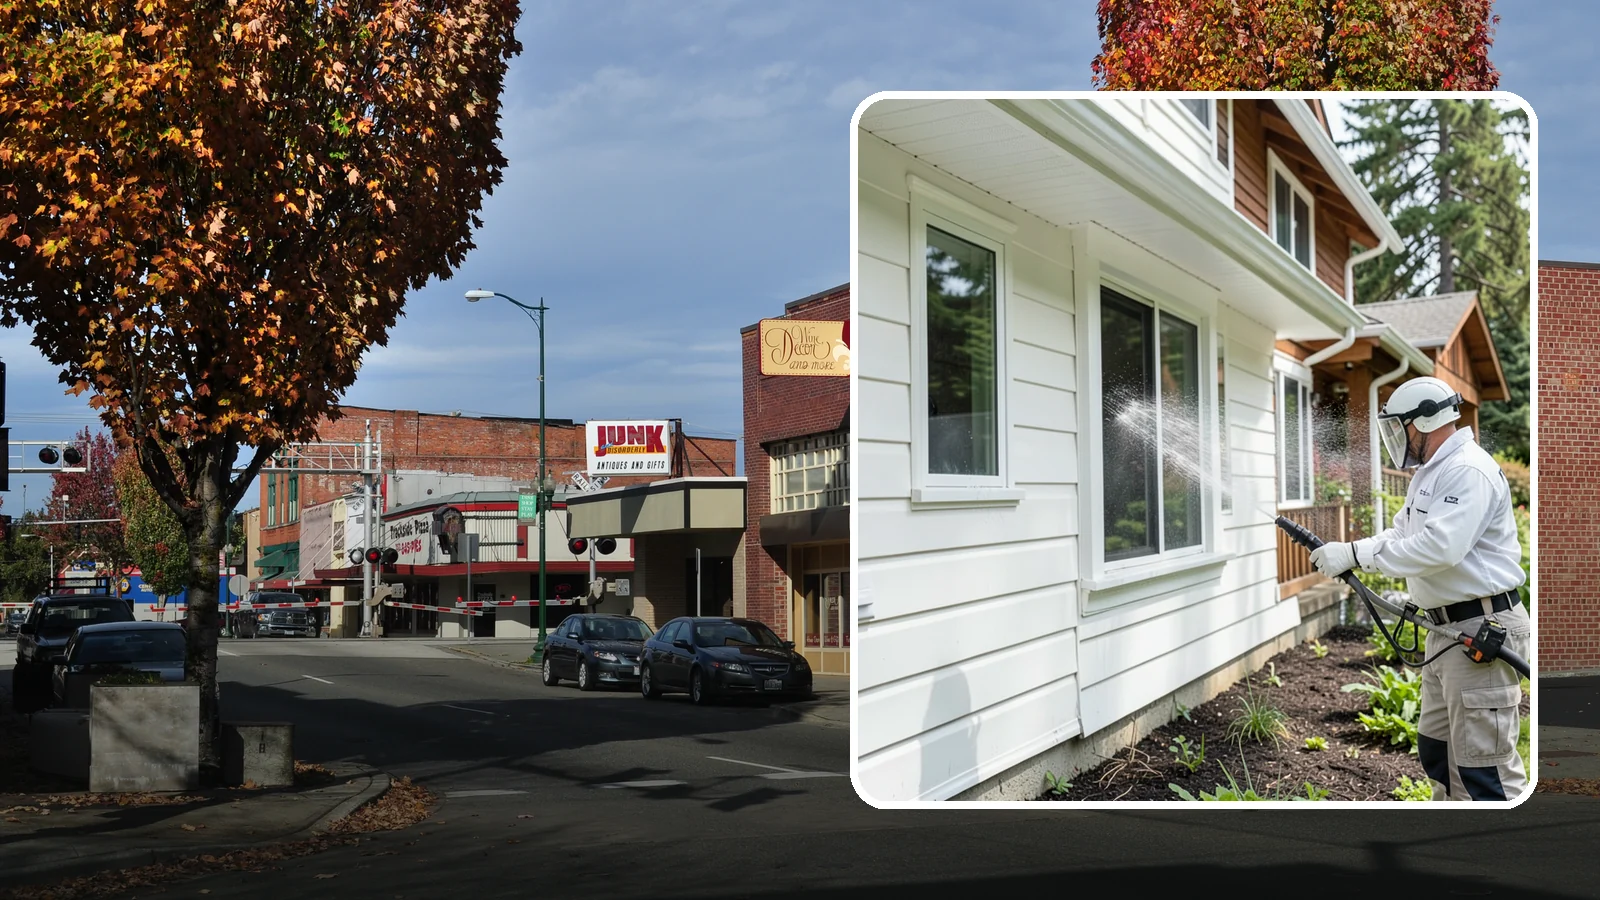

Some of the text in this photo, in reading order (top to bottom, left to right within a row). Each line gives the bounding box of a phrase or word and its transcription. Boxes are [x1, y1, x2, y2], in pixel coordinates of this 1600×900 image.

[595, 425, 665, 457] JUNK
[607, 446, 646, 454] DISORDERLY
[597, 460, 665, 470] ANTIQUES AND GIFTS
